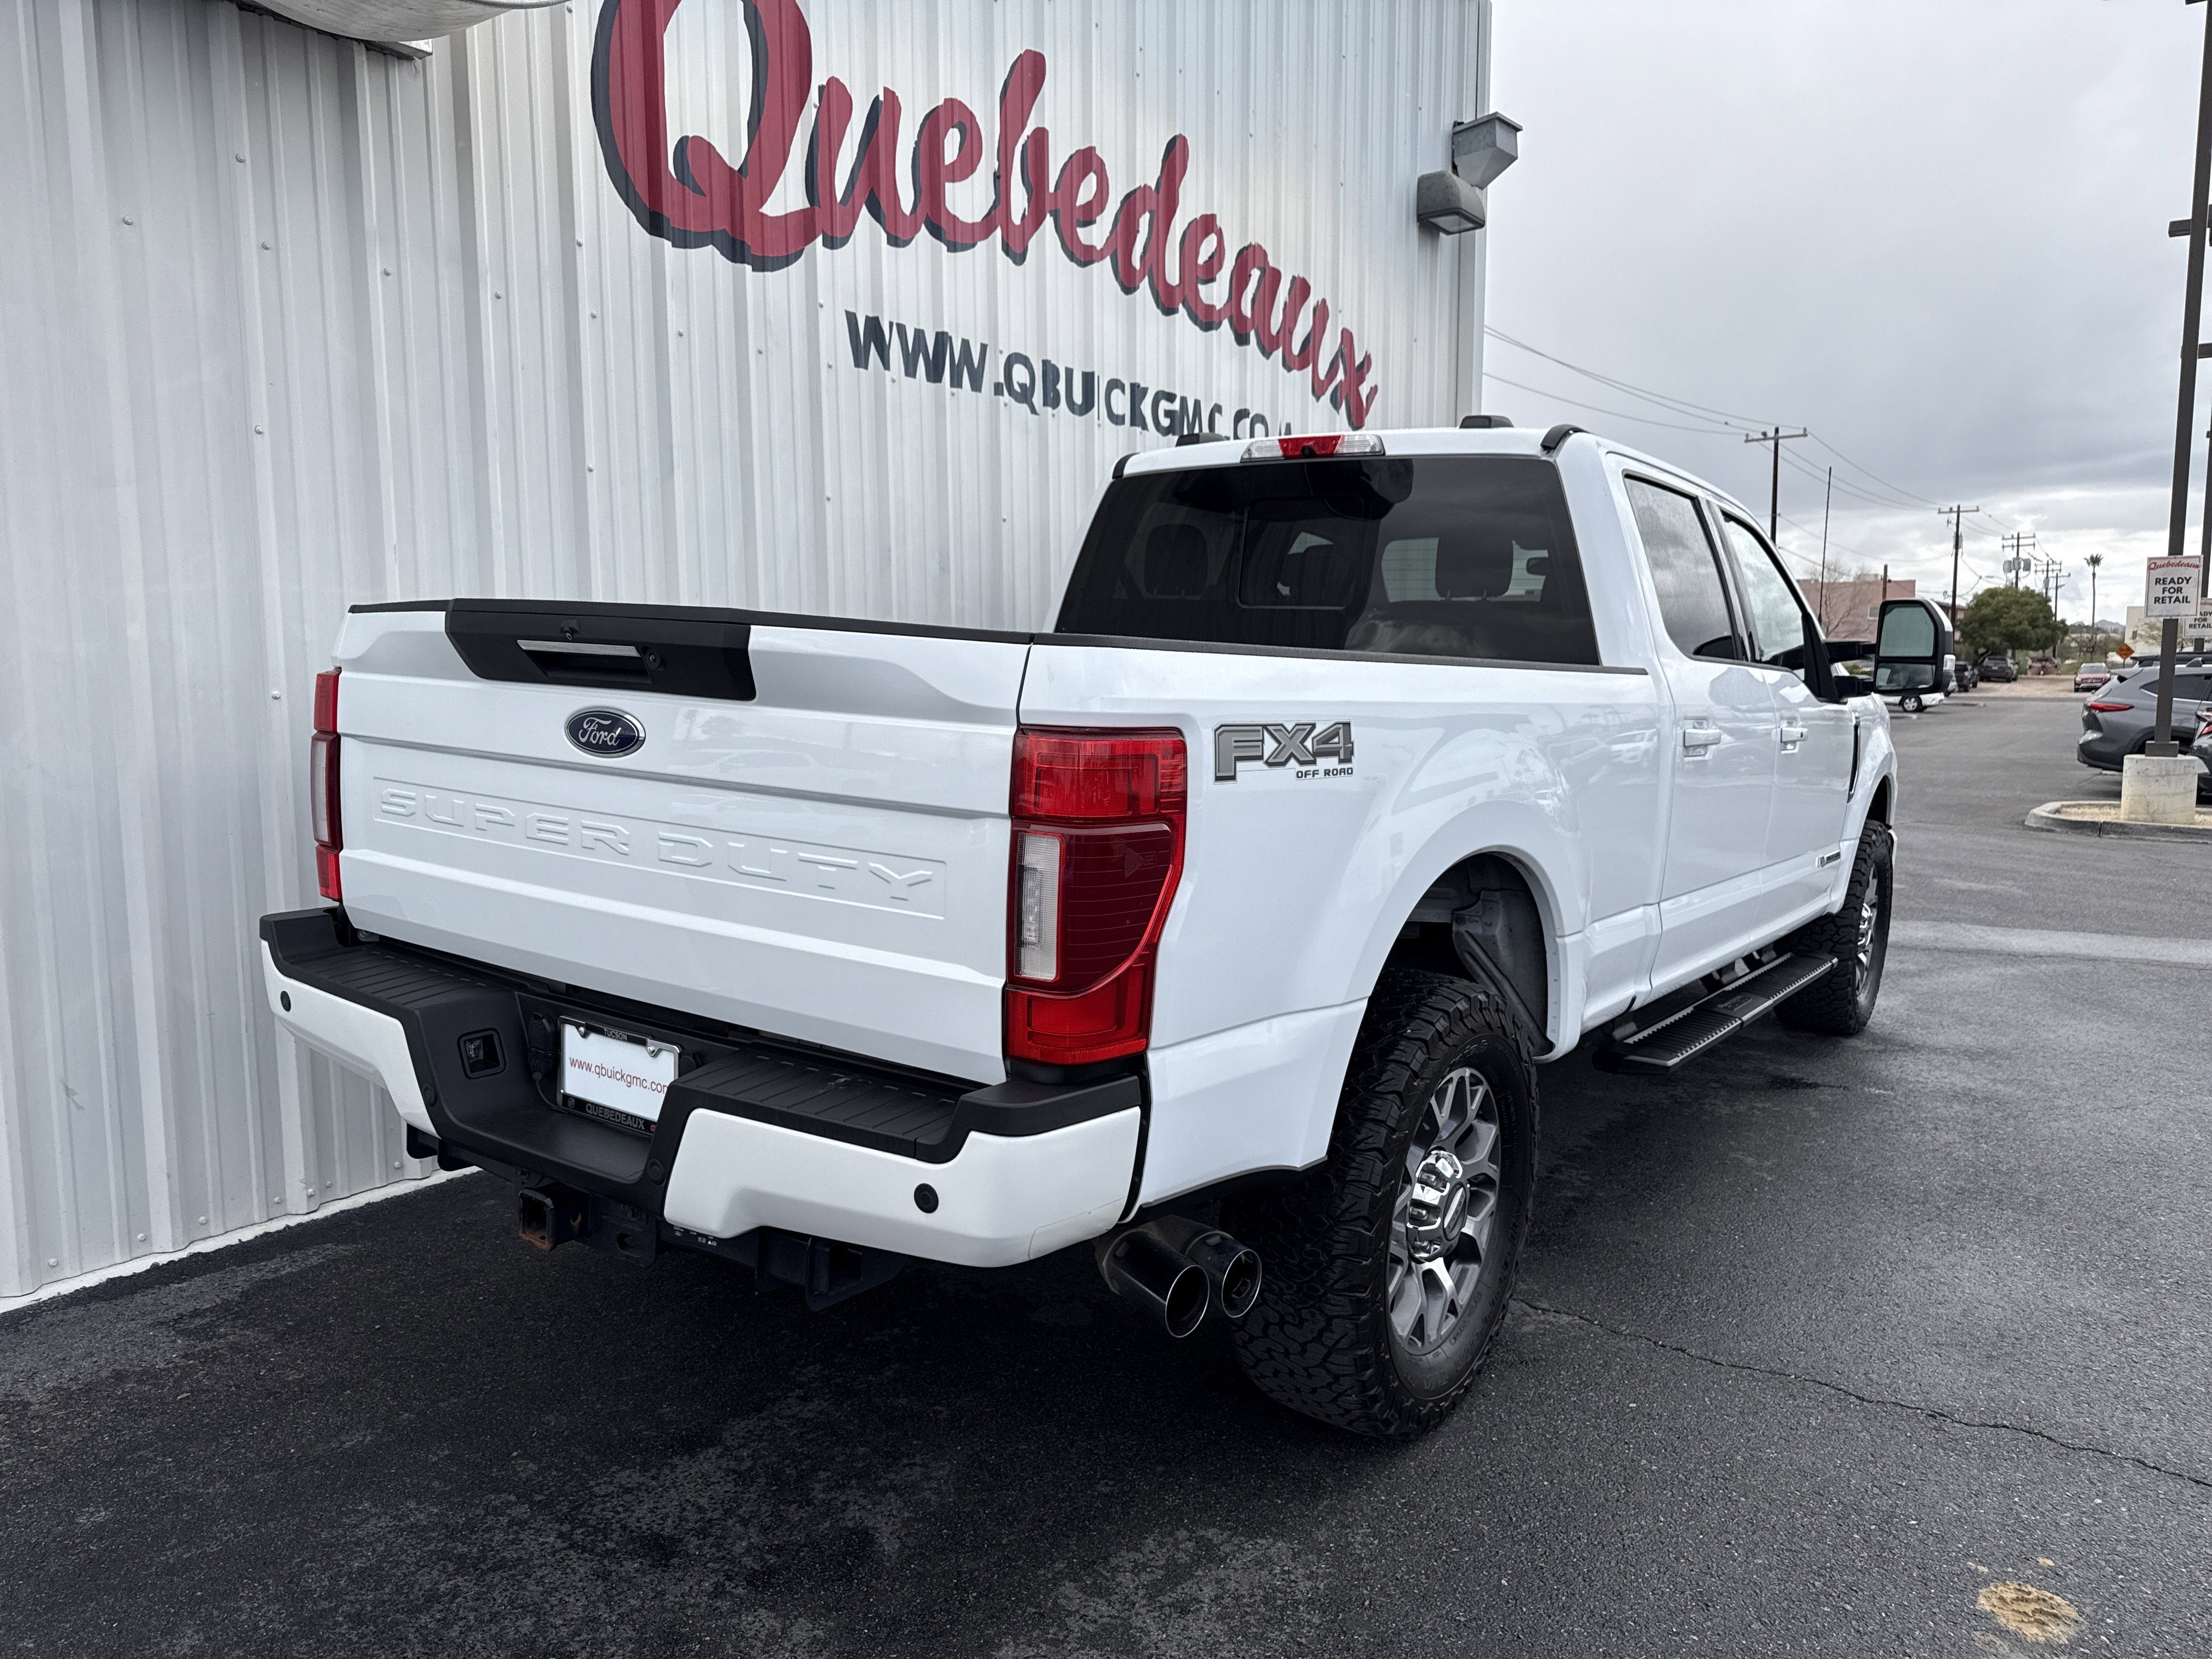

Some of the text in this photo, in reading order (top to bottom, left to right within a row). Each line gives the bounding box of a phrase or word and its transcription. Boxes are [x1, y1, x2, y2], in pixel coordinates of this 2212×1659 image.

[591, 0, 1378, 429] Quebedeaux
[2148, 560, 2200, 571] Quebedeaux
[2155, 577, 2192, 585] READY
[2162, 586, 2183, 595] FOR
[2154, 596, 2191, 604] RETAIL
[579, 717, 622, 746] Ford
[1214, 721, 1354, 782] FX4
[1296, 768, 1353, 778] OFF ROAD
[382, 788, 932, 901] SUPER DUTY
[603, 1028, 628, 1041] TUCSON
[585, 1103, 645, 1130] QUEBEDEAUX
